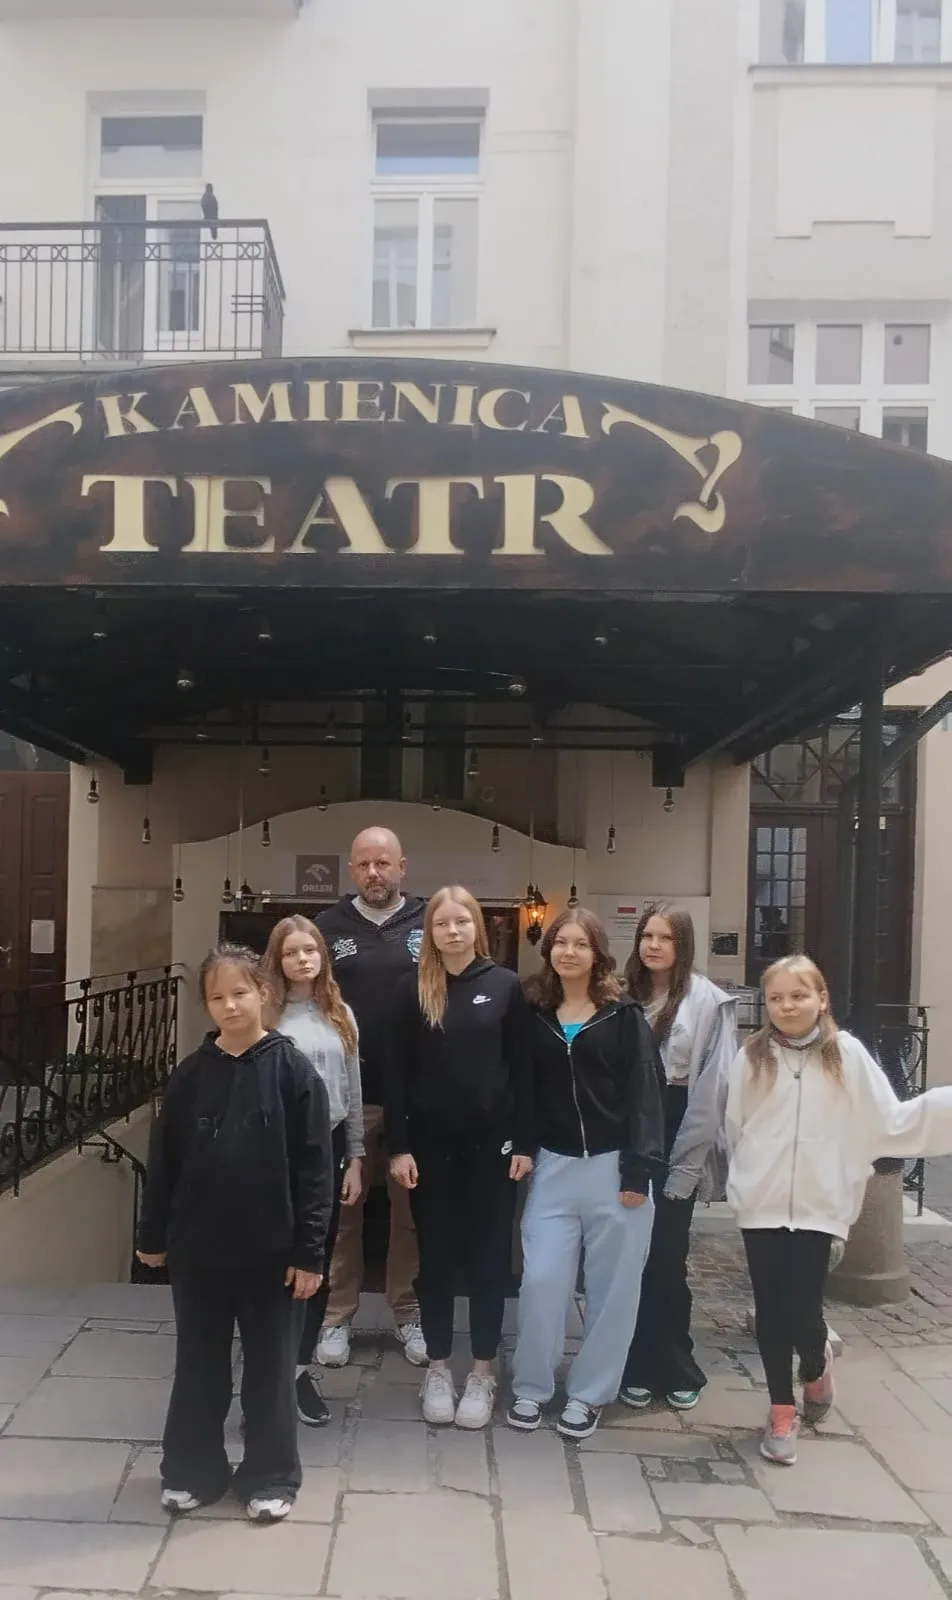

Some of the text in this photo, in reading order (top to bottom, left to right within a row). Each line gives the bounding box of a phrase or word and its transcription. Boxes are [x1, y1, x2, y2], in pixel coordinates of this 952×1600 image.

[96, 380, 590, 438] KAMIENICA
[81, 474, 613, 556] TEATR
[302, 884, 333, 893] ORLEN
